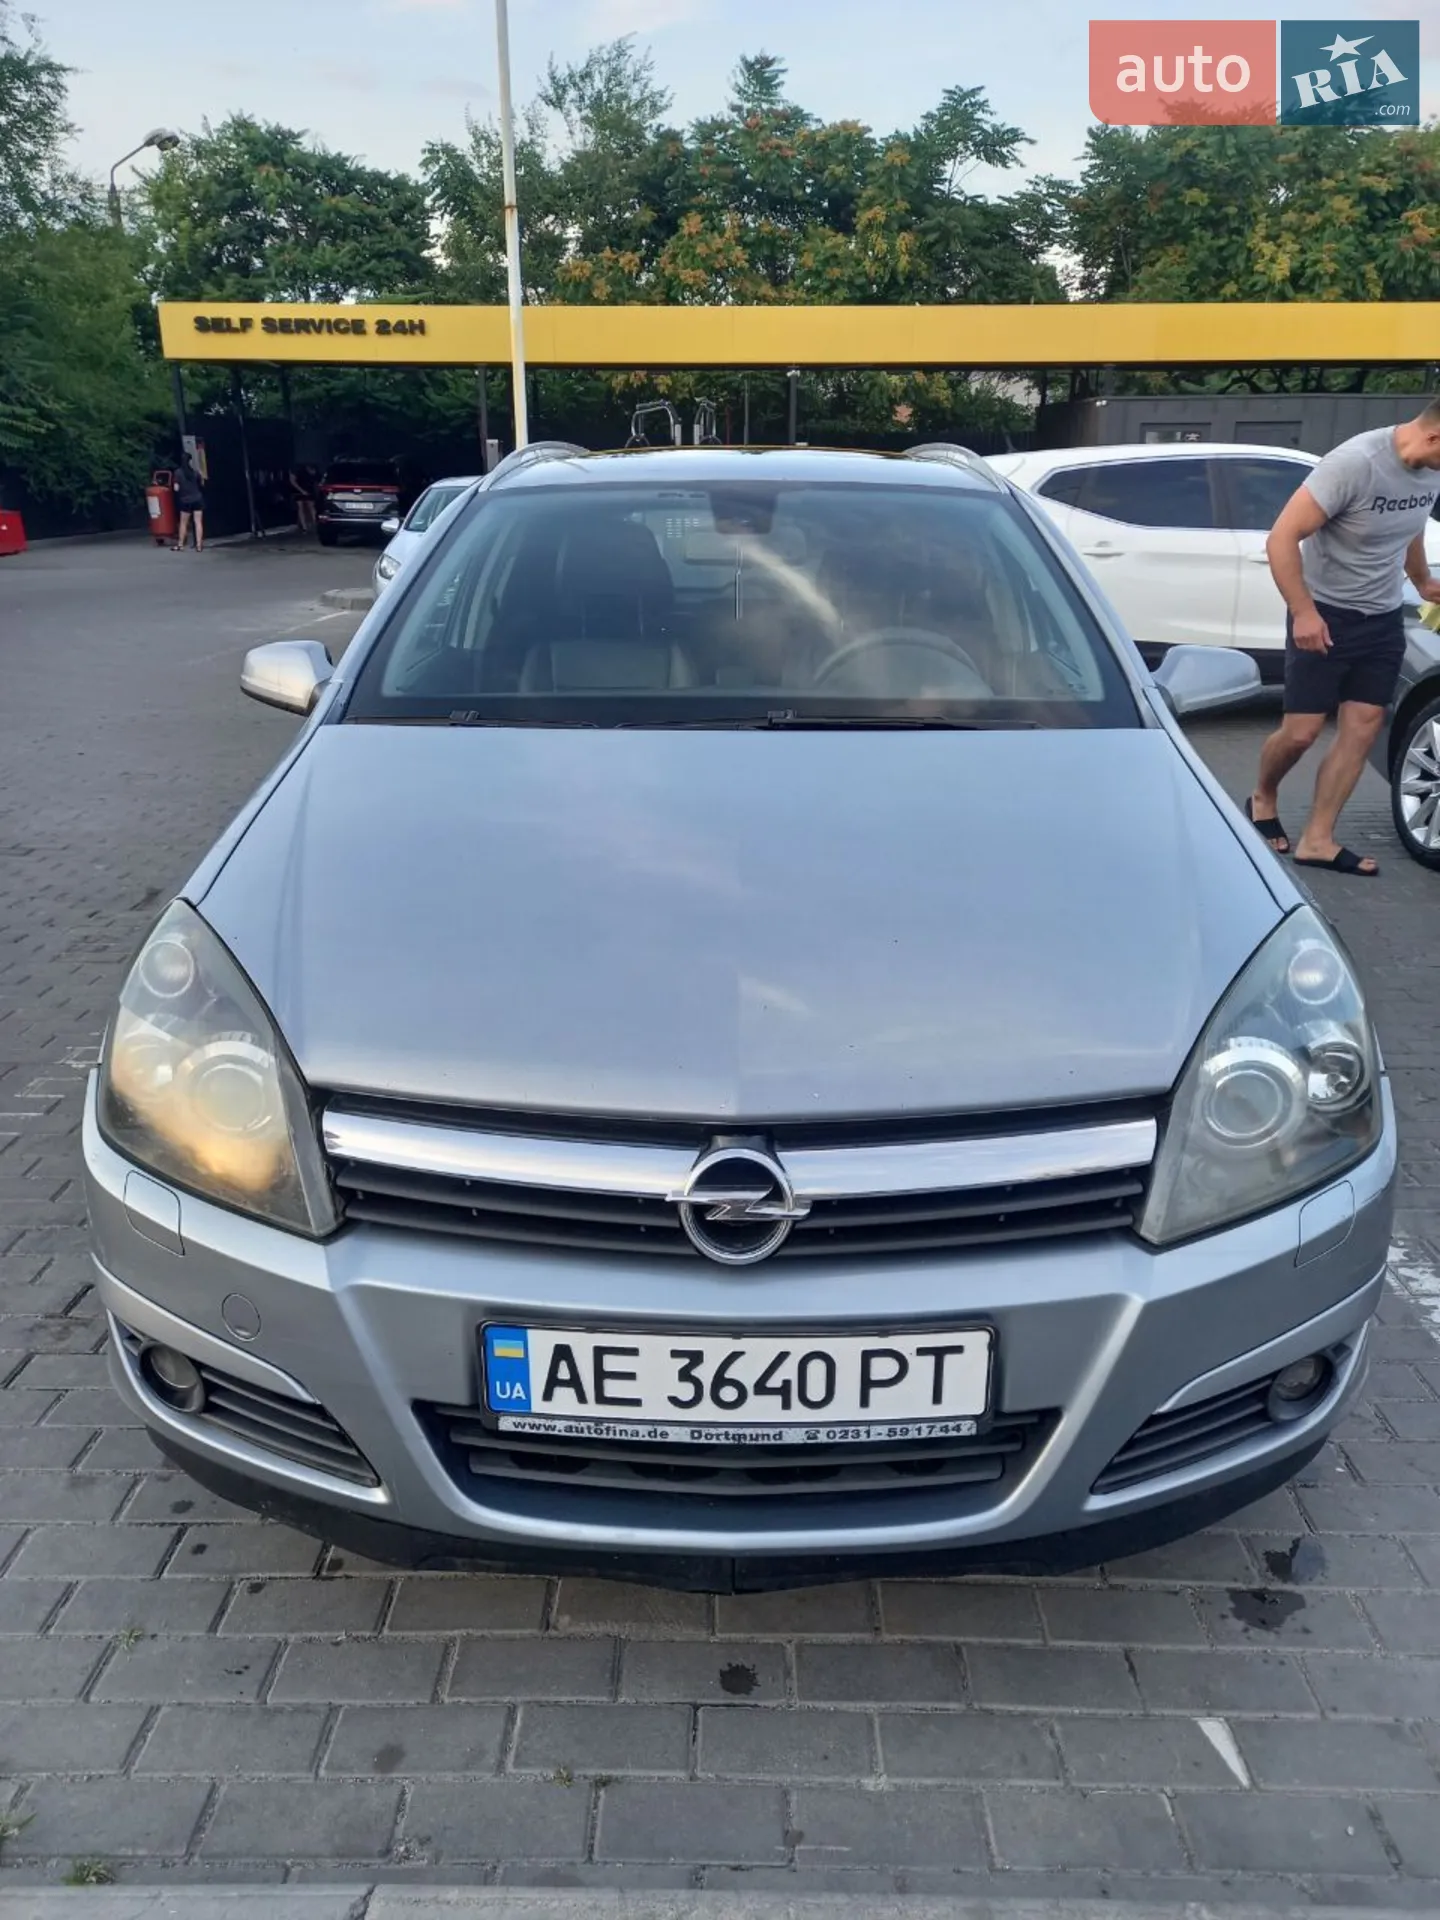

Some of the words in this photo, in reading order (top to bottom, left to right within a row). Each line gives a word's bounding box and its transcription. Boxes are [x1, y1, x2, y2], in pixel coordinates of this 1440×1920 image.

[194, 316, 253, 334] SELF
[261, 317, 367, 336] SERVICE
[375, 318, 426, 336] 24H
[1370, 491, 1435, 515] Reebok
[542, 1343, 643, 1408] AE
[667, 1349, 837, 1411] 3640
[859, 1345, 966, 1409] PT
[495, 1380, 527, 1401] UA
[689, 1429, 784, 1443] Dortmund
